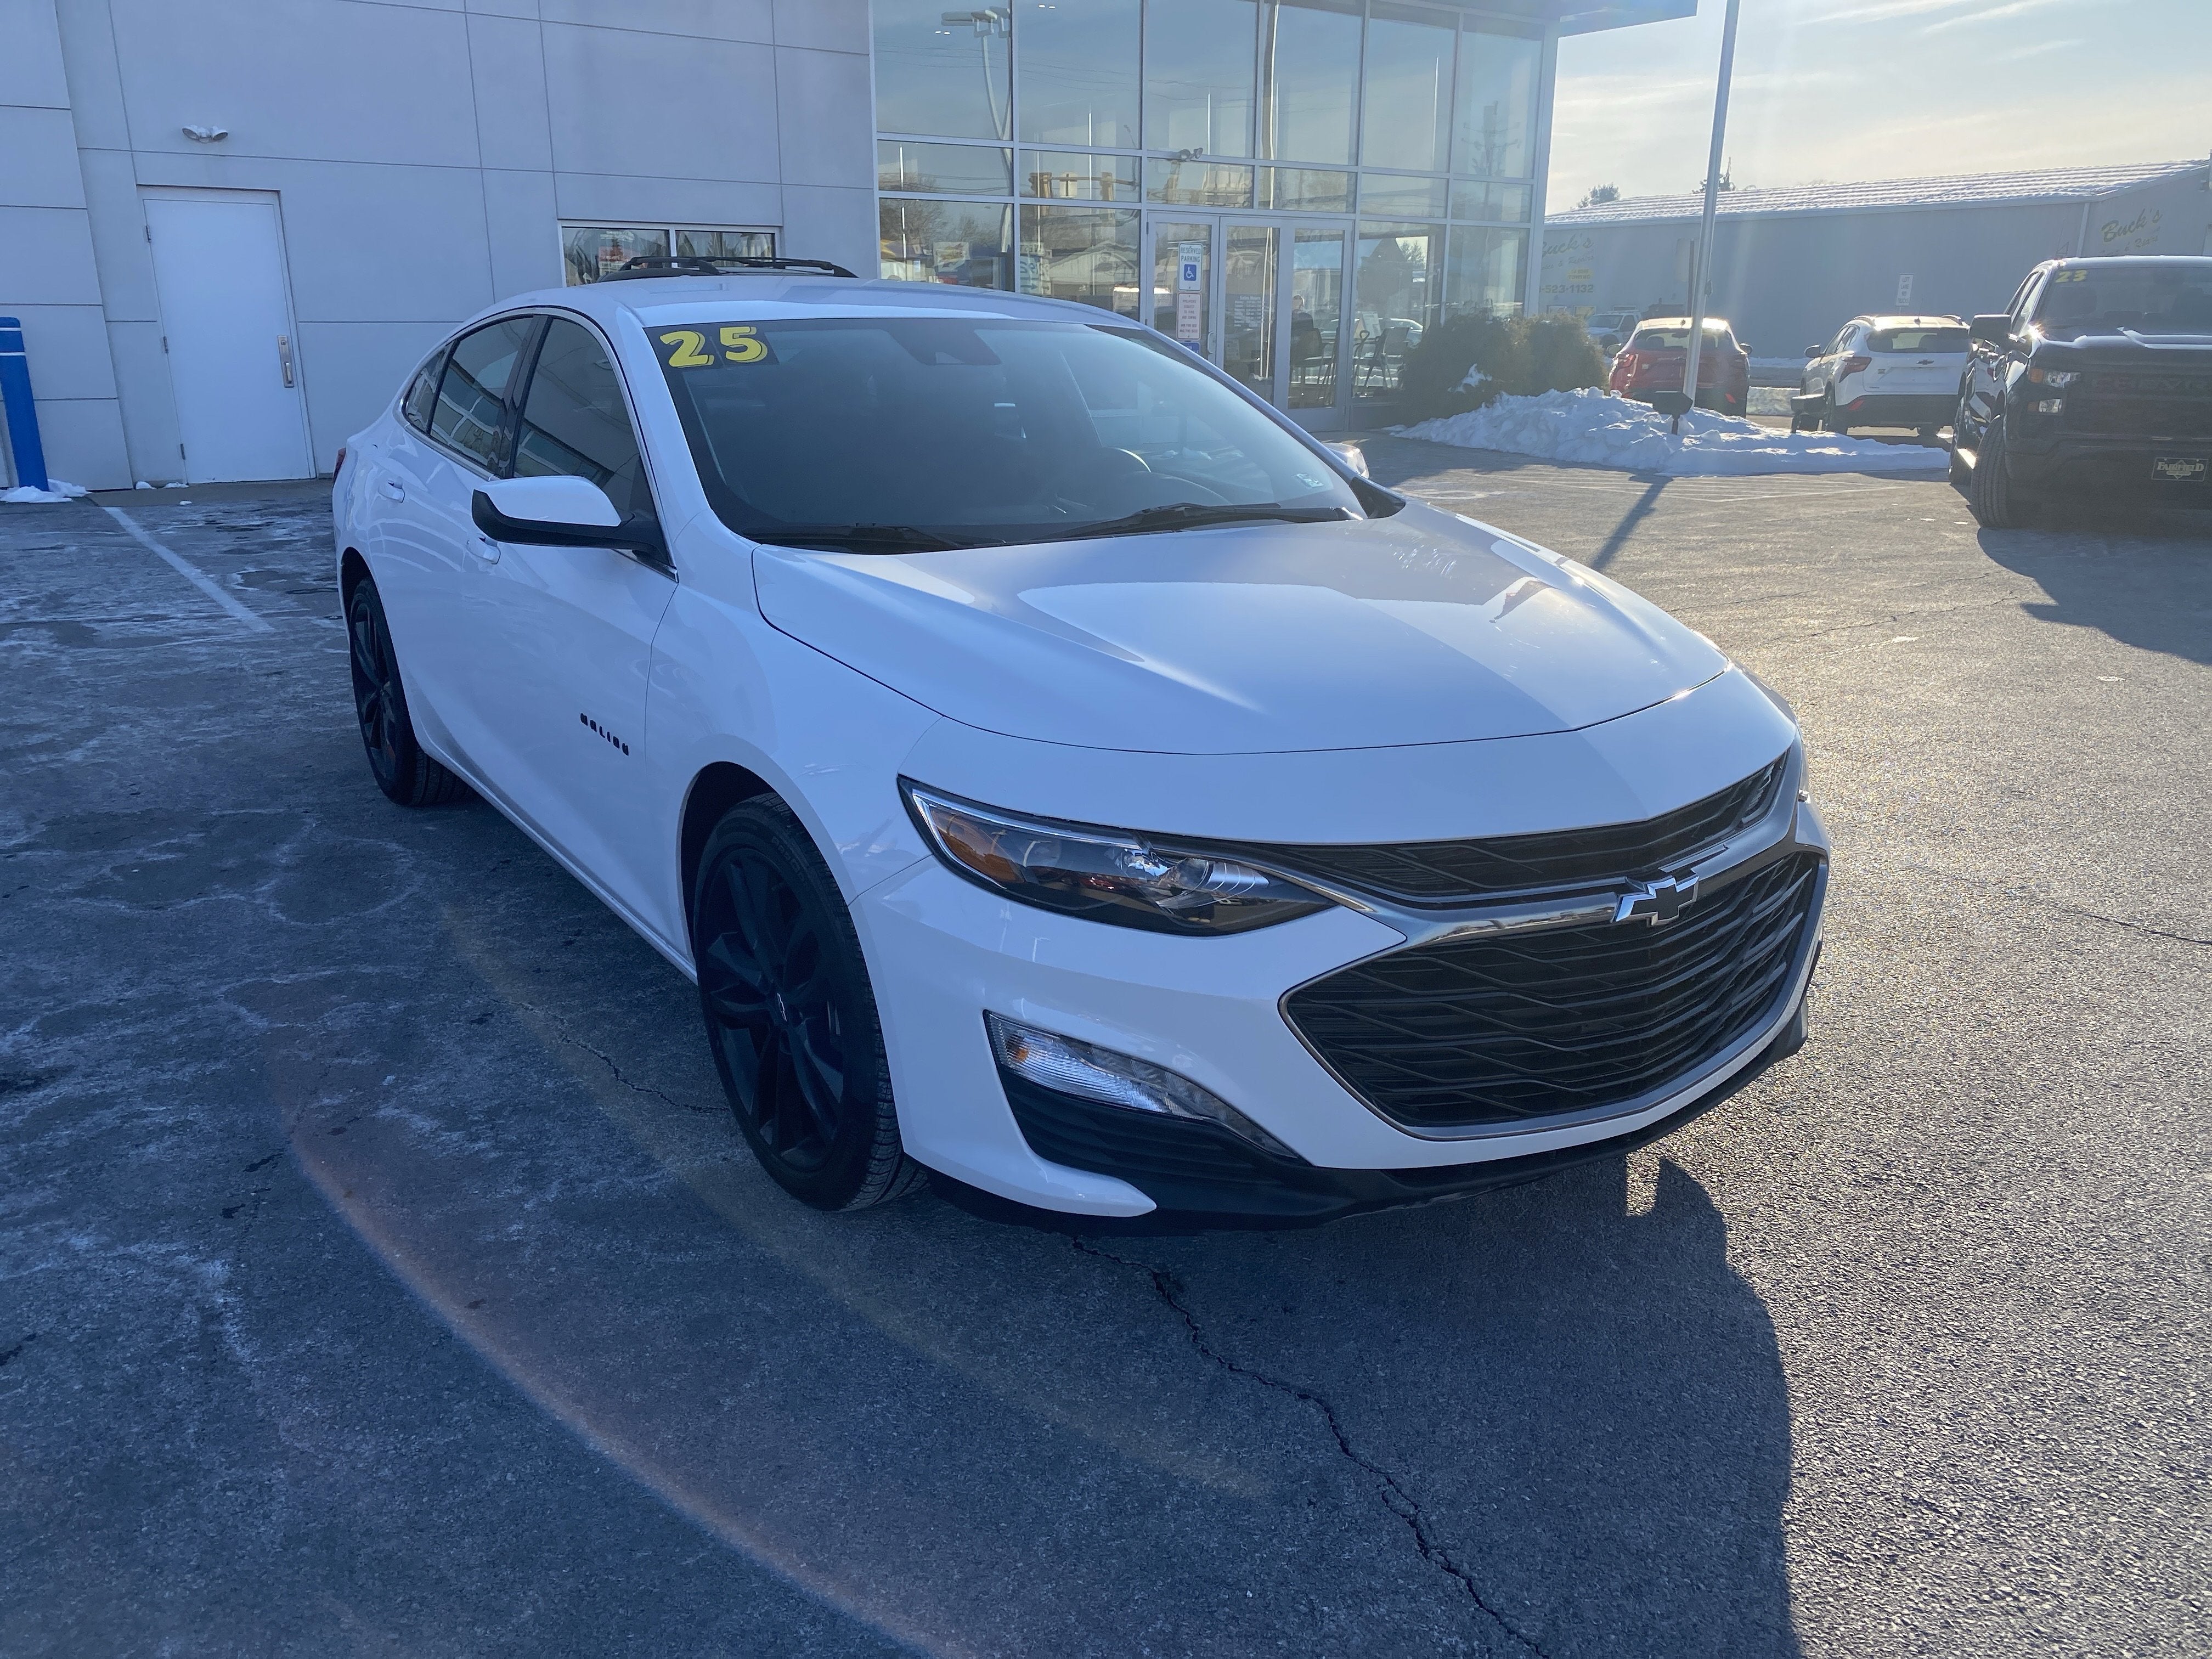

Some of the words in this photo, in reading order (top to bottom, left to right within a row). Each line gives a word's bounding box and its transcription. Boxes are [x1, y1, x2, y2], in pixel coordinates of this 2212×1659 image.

[2101, 208, 2163, 242] Buck's
[2055, 270, 2087, 283] 23
[660, 326, 768, 368] 25
